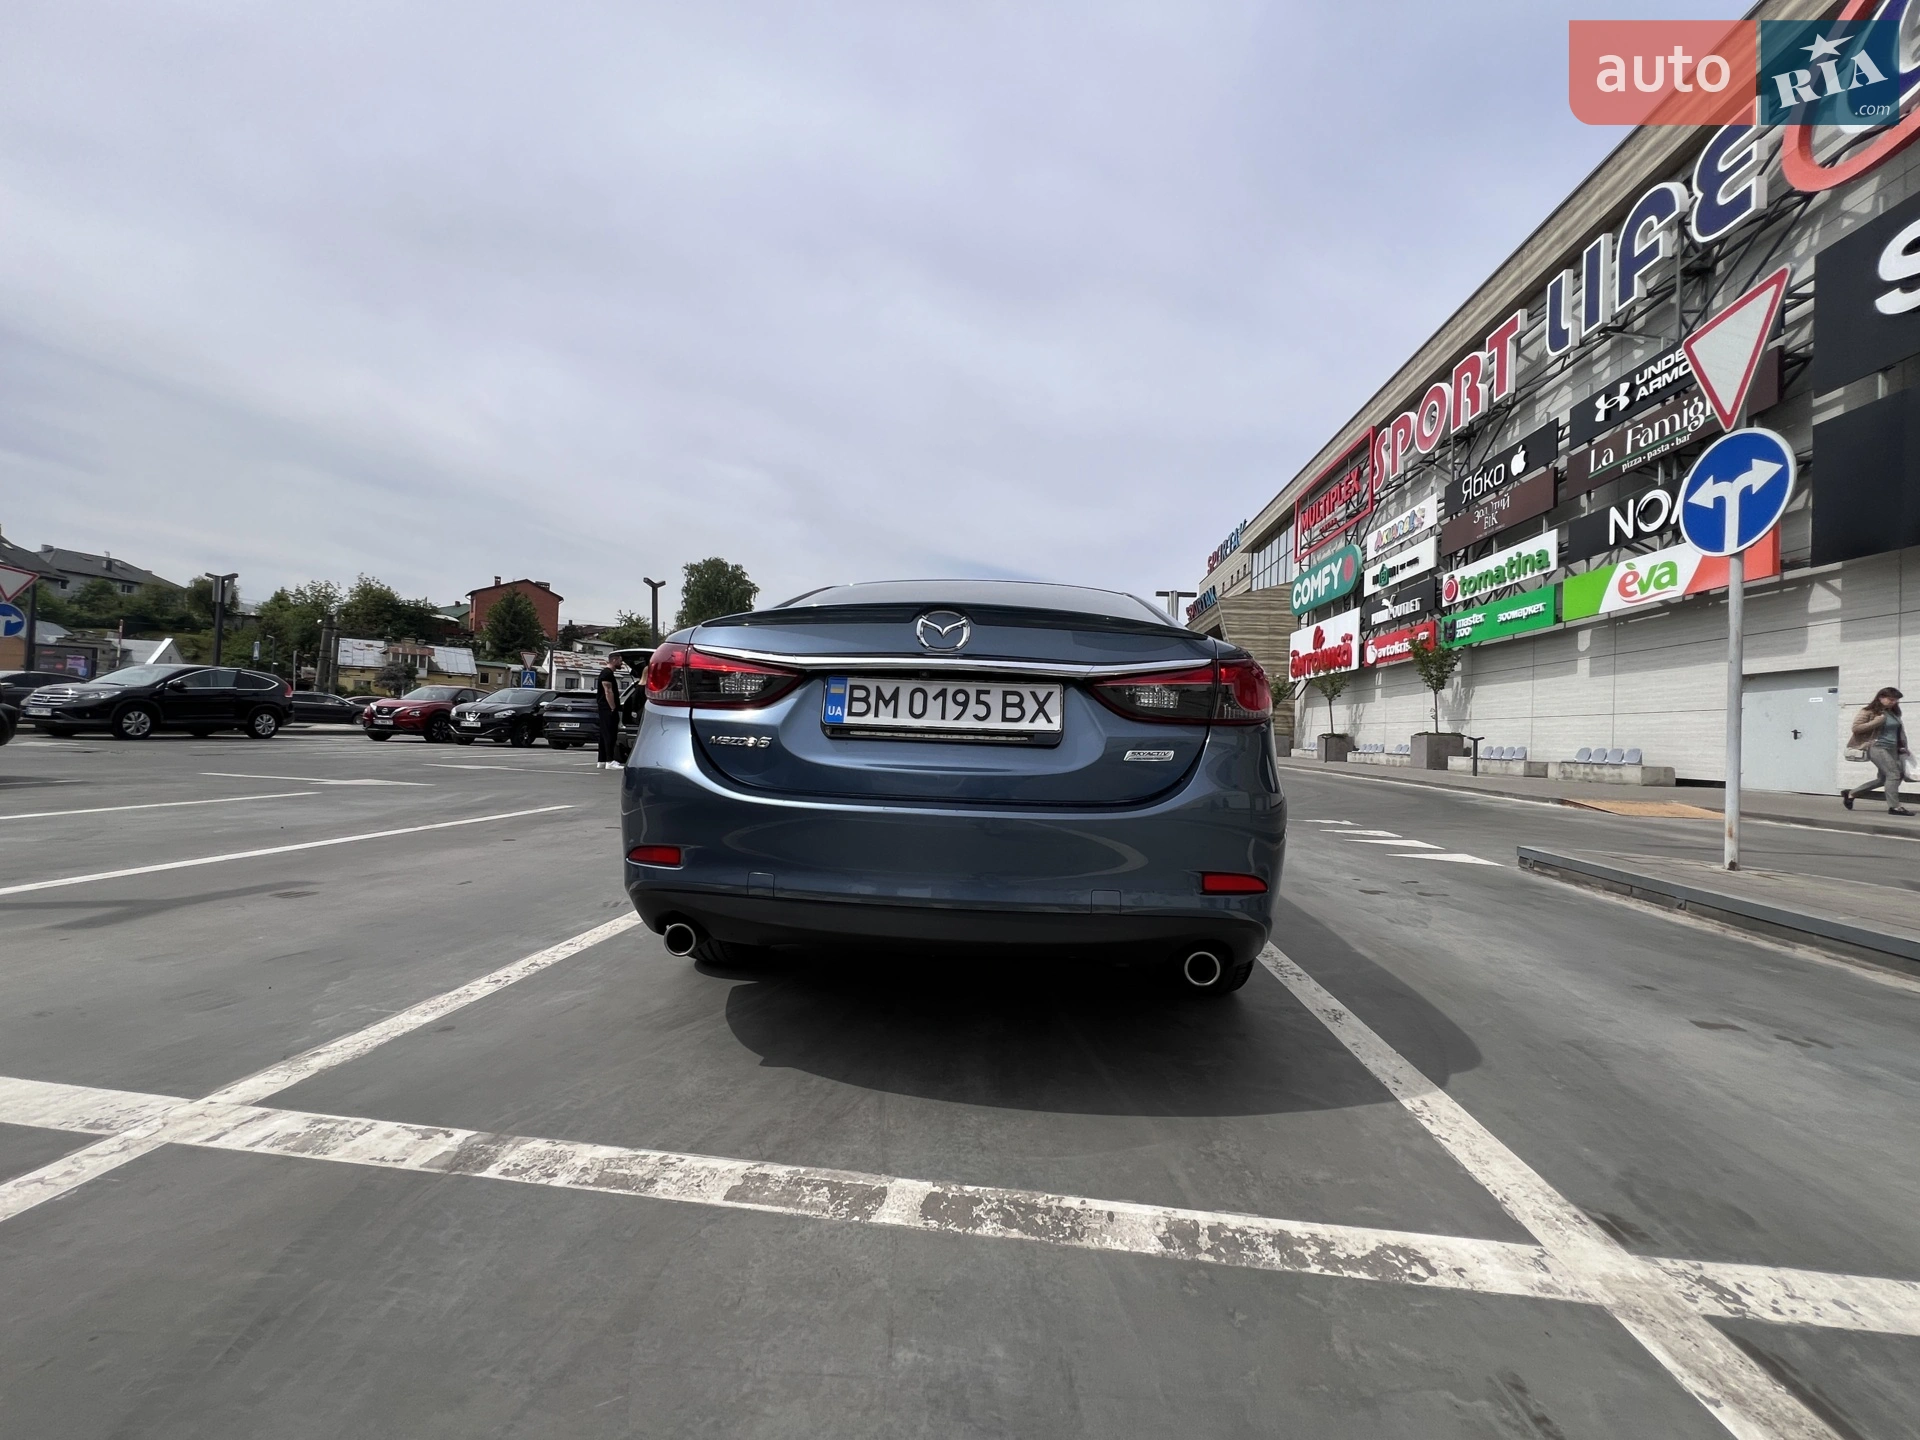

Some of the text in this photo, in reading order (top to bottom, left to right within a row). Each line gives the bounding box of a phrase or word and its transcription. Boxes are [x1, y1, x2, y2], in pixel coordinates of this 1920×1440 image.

[1373, 96, 1769, 495] SPORT LIFE
[1635, 349, 1687, 385] UNDE
[1635, 361, 1692, 401] ARMO
[1589, 396, 1712, 473] La Famigl
[1622, 433, 1692, 473] pizza pasta bar
[1301, 465, 1361, 534] MULTIPLEX
[1461, 463, 1505, 504] Ябко
[1292, 557, 1342, 610] COMFY
[1459, 549, 1551, 597] tomatina
[1456, 612, 1487, 628] master
[1456, 626, 1473, 638] zoo
[1496, 602, 1547, 622] зоомаркет
[827, 704, 843, 717] UA
[847, 684, 1054, 724] BM 0195 BX
